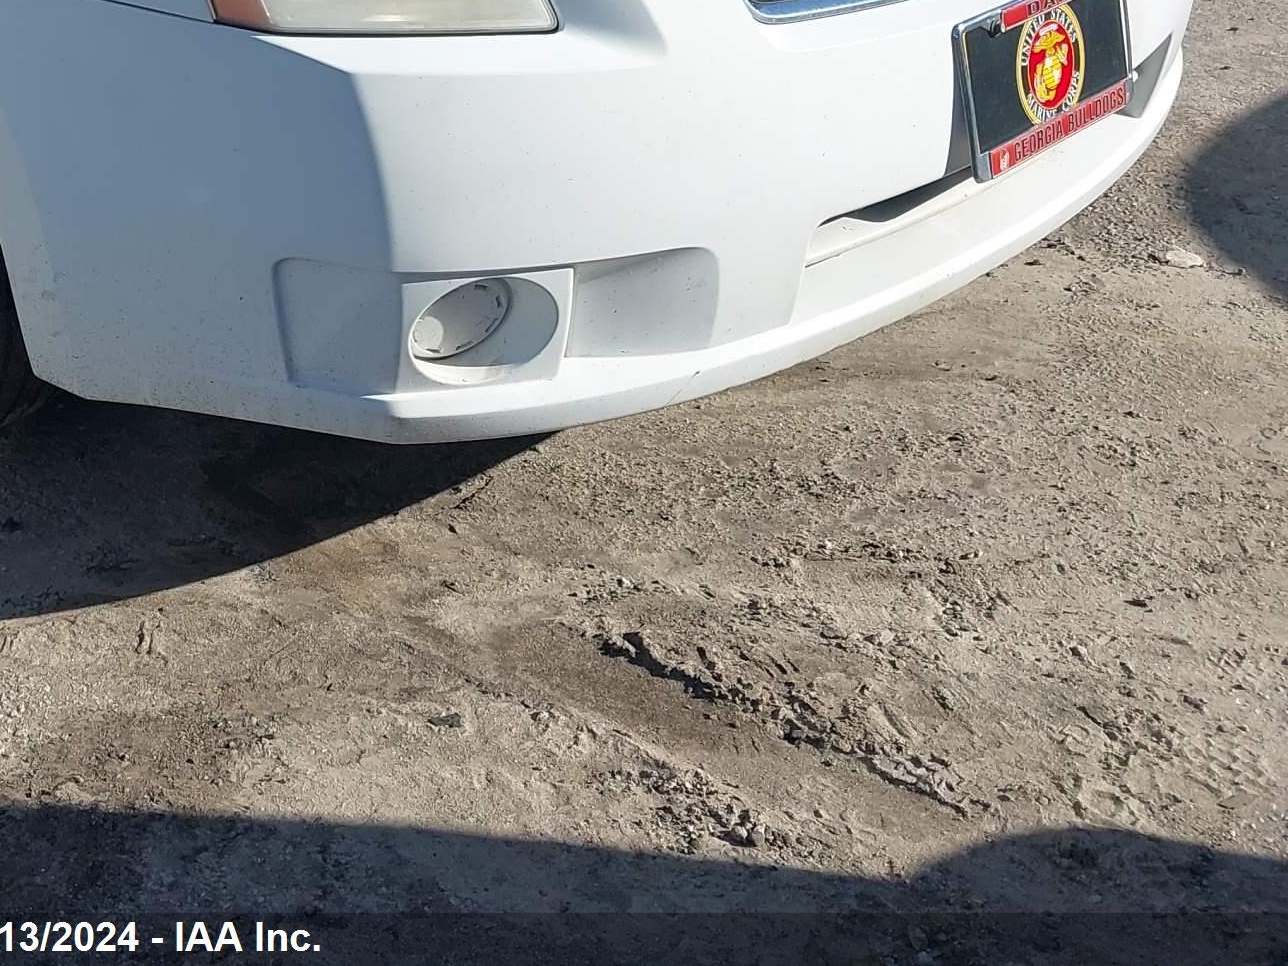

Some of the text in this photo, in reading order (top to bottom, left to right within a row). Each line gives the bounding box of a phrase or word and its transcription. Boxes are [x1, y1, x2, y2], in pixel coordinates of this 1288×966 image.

[1021, 7, 1078, 66] UNITED STATES
[1014, 87, 1125, 162] GEORGIA BULLDOGS
